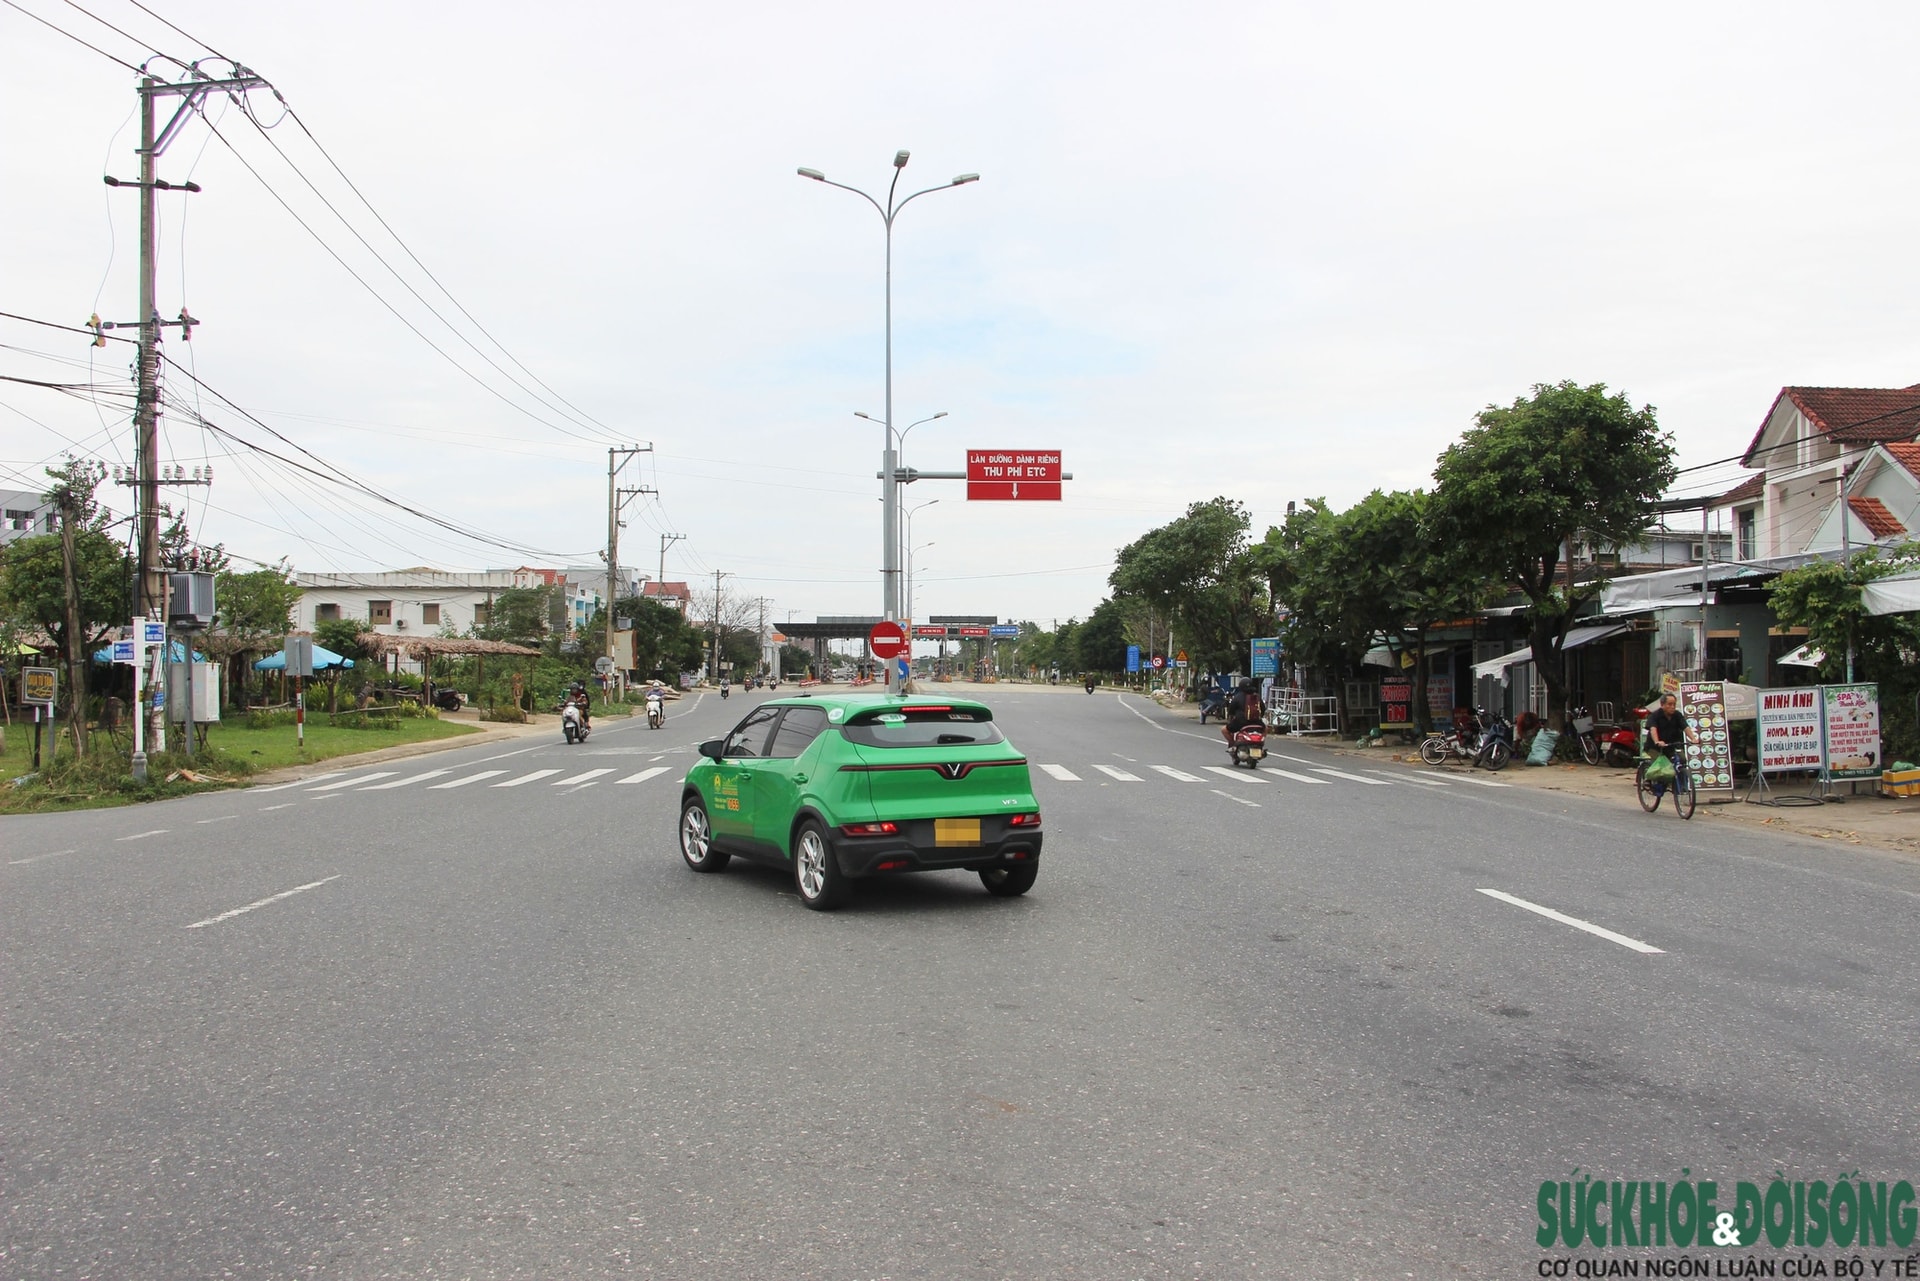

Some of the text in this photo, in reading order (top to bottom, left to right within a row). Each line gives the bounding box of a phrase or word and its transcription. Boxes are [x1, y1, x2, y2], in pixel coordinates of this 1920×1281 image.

[970, 453, 1059, 464] LÀN ĐƯỜNG DÀNH RIÊNG
[984, 465, 1046, 477] THU PHÍ ETC
[1687, 692, 1718, 701] Menu
[1764, 691, 1813, 710] MINH ÁNH
[1837, 693, 1852, 701] SPA
[1791, 726, 1799, 736] XE
[1801, 725, 1814, 738] ĐẠP
